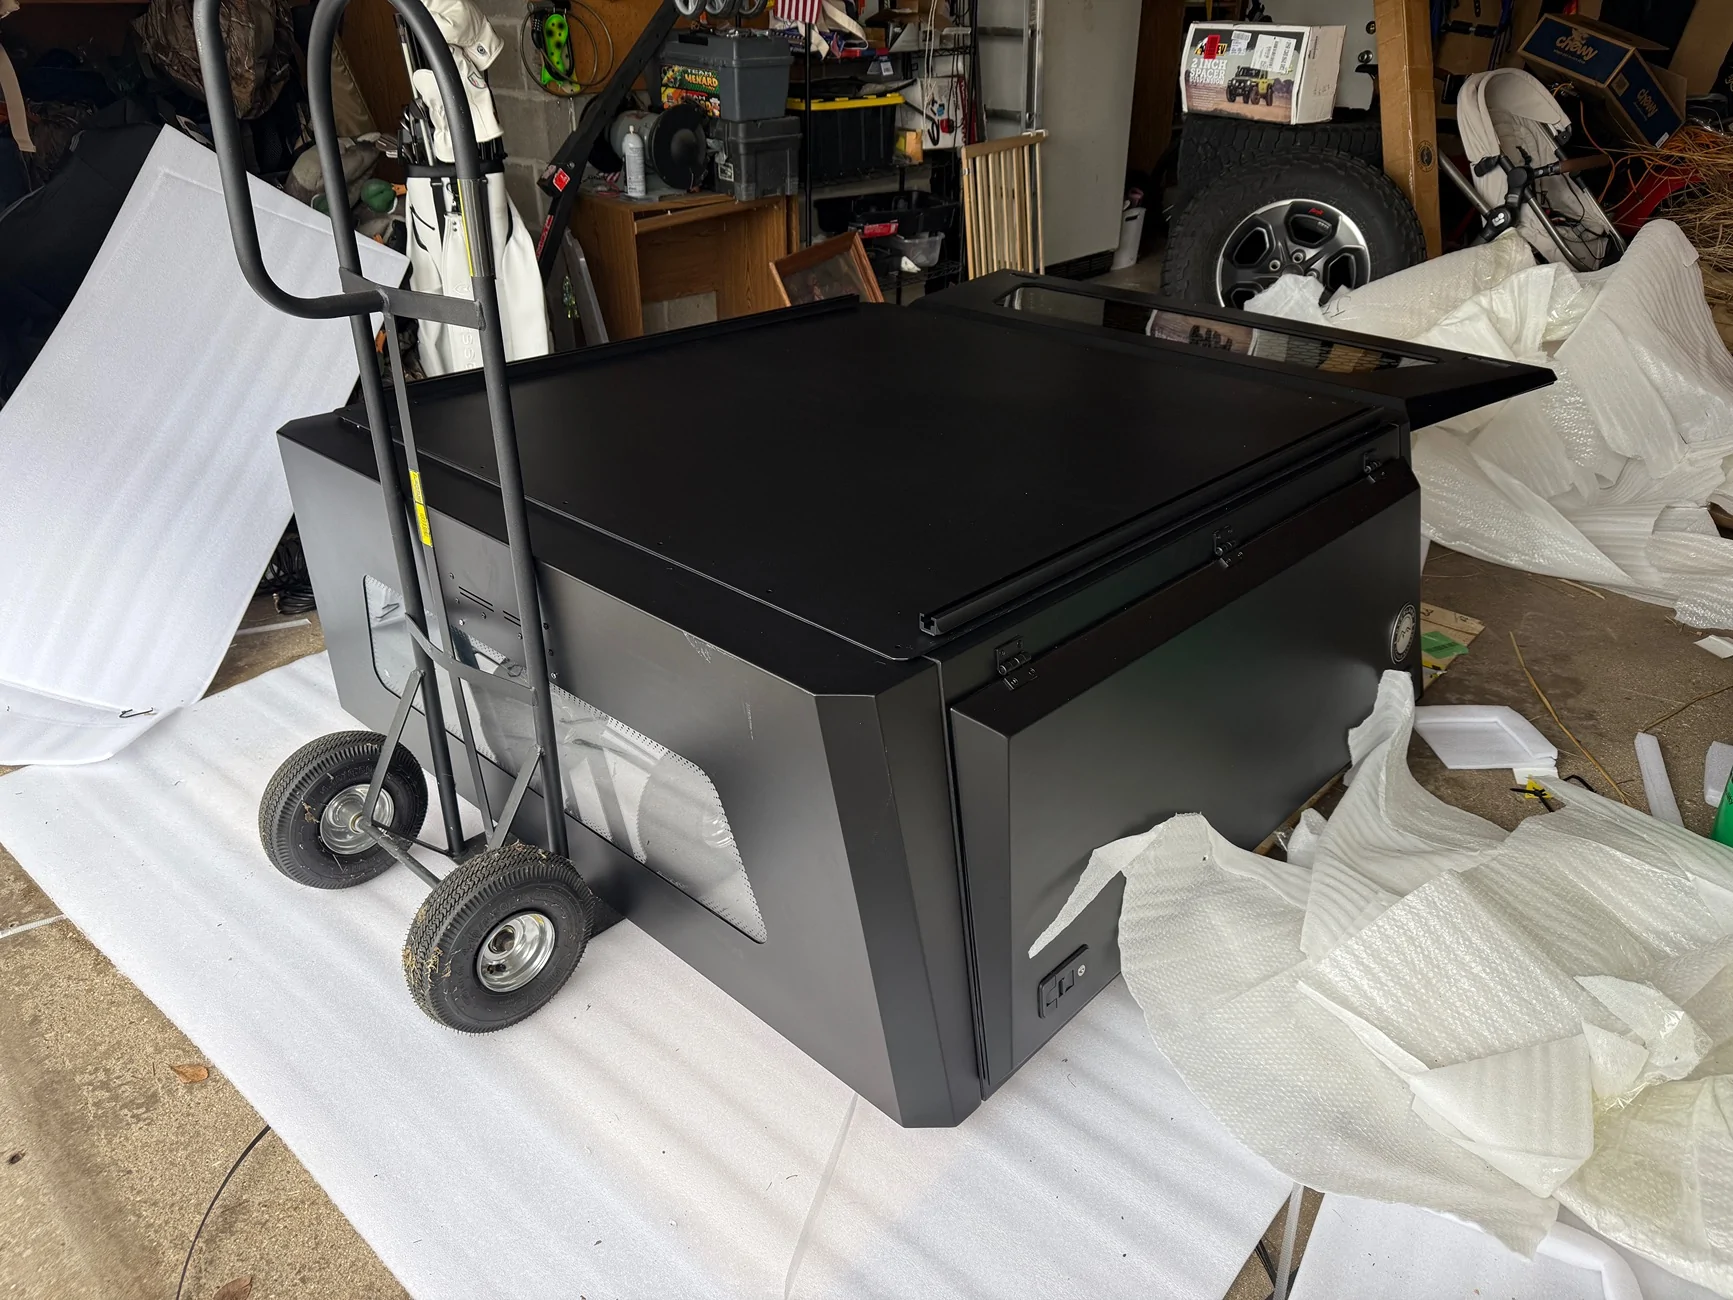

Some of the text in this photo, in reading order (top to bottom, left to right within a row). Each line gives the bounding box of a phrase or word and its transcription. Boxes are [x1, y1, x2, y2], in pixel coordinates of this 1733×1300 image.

[1555, 36, 1598, 61] chewy
[1190, 57, 1227, 70] 2 INCH
[685, 73, 718, 87] MENARD
[1190, 68, 1225, 79] SPACER
